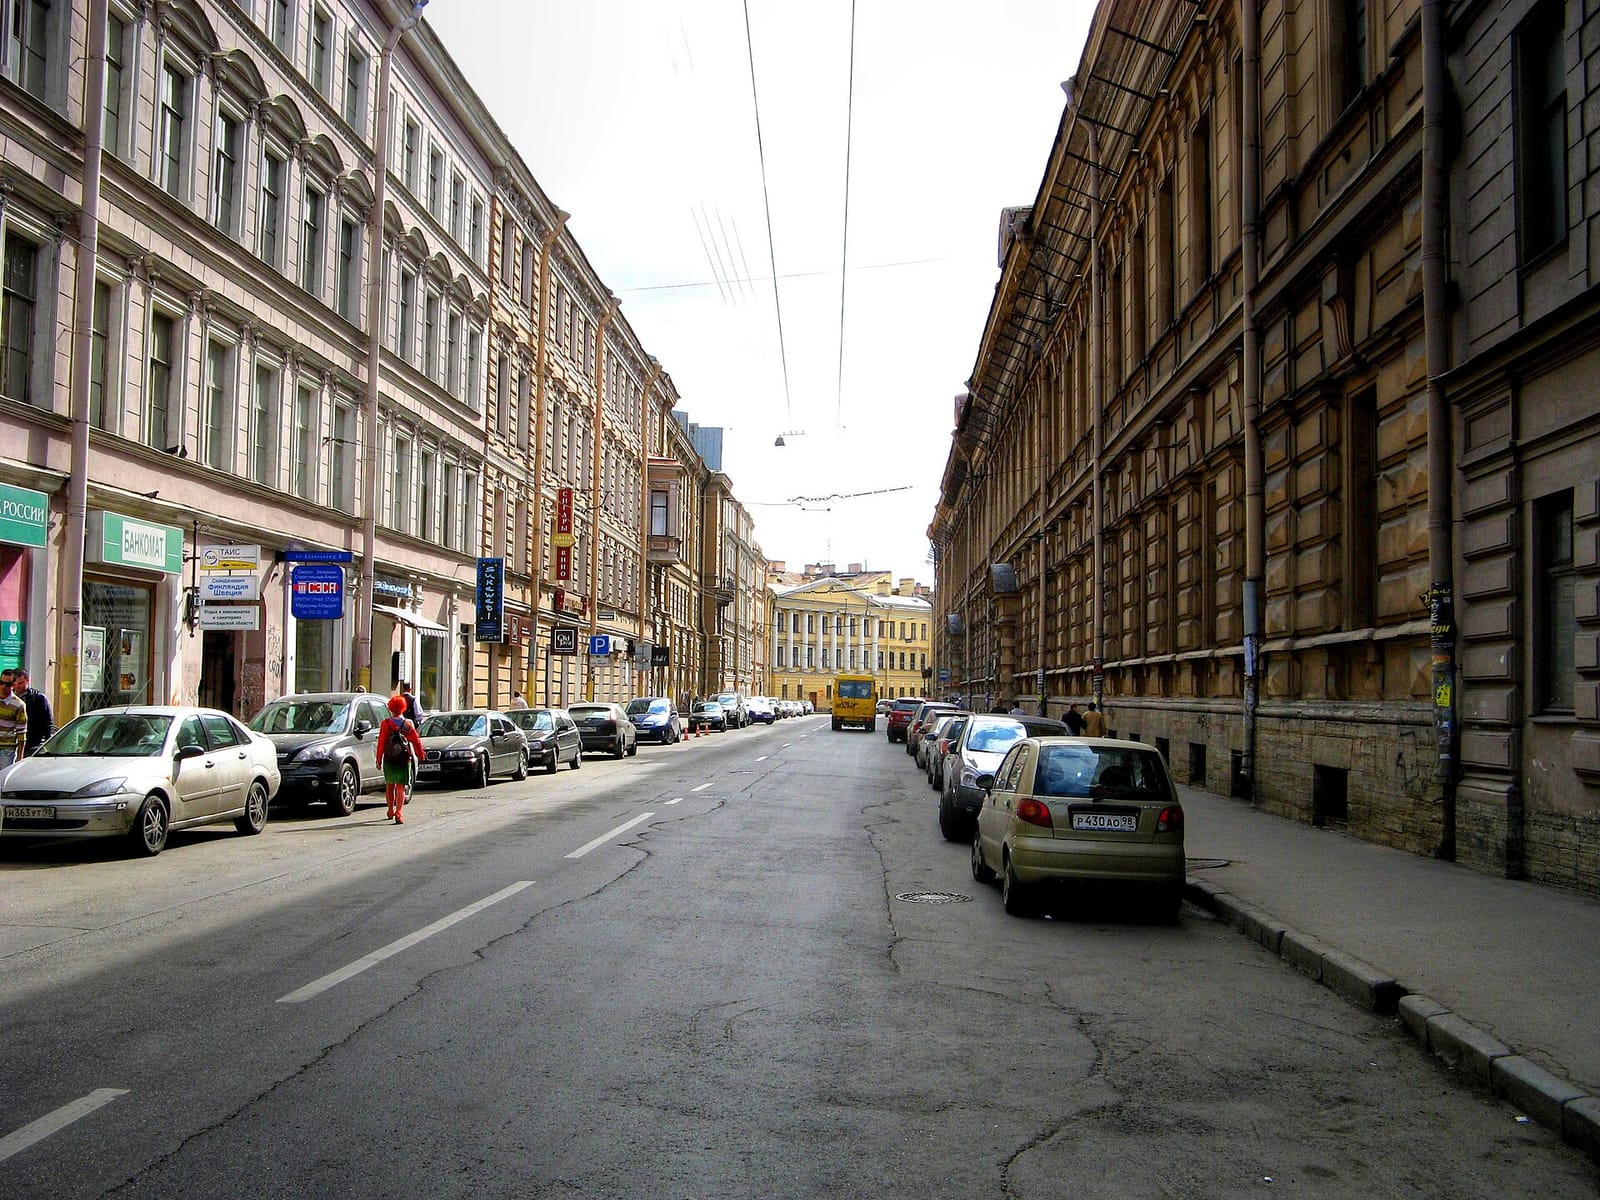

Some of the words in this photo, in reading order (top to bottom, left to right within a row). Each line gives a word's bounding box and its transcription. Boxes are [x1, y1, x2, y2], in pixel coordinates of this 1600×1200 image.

[3, 500, 45, 523] РОССИИ
[560, 491, 568, 532] СИГАРЫ
[124, 529, 164, 559] БАНКОМАТ
[557, 634, 570, 642] Old
[595, 637, 606, 653] P
